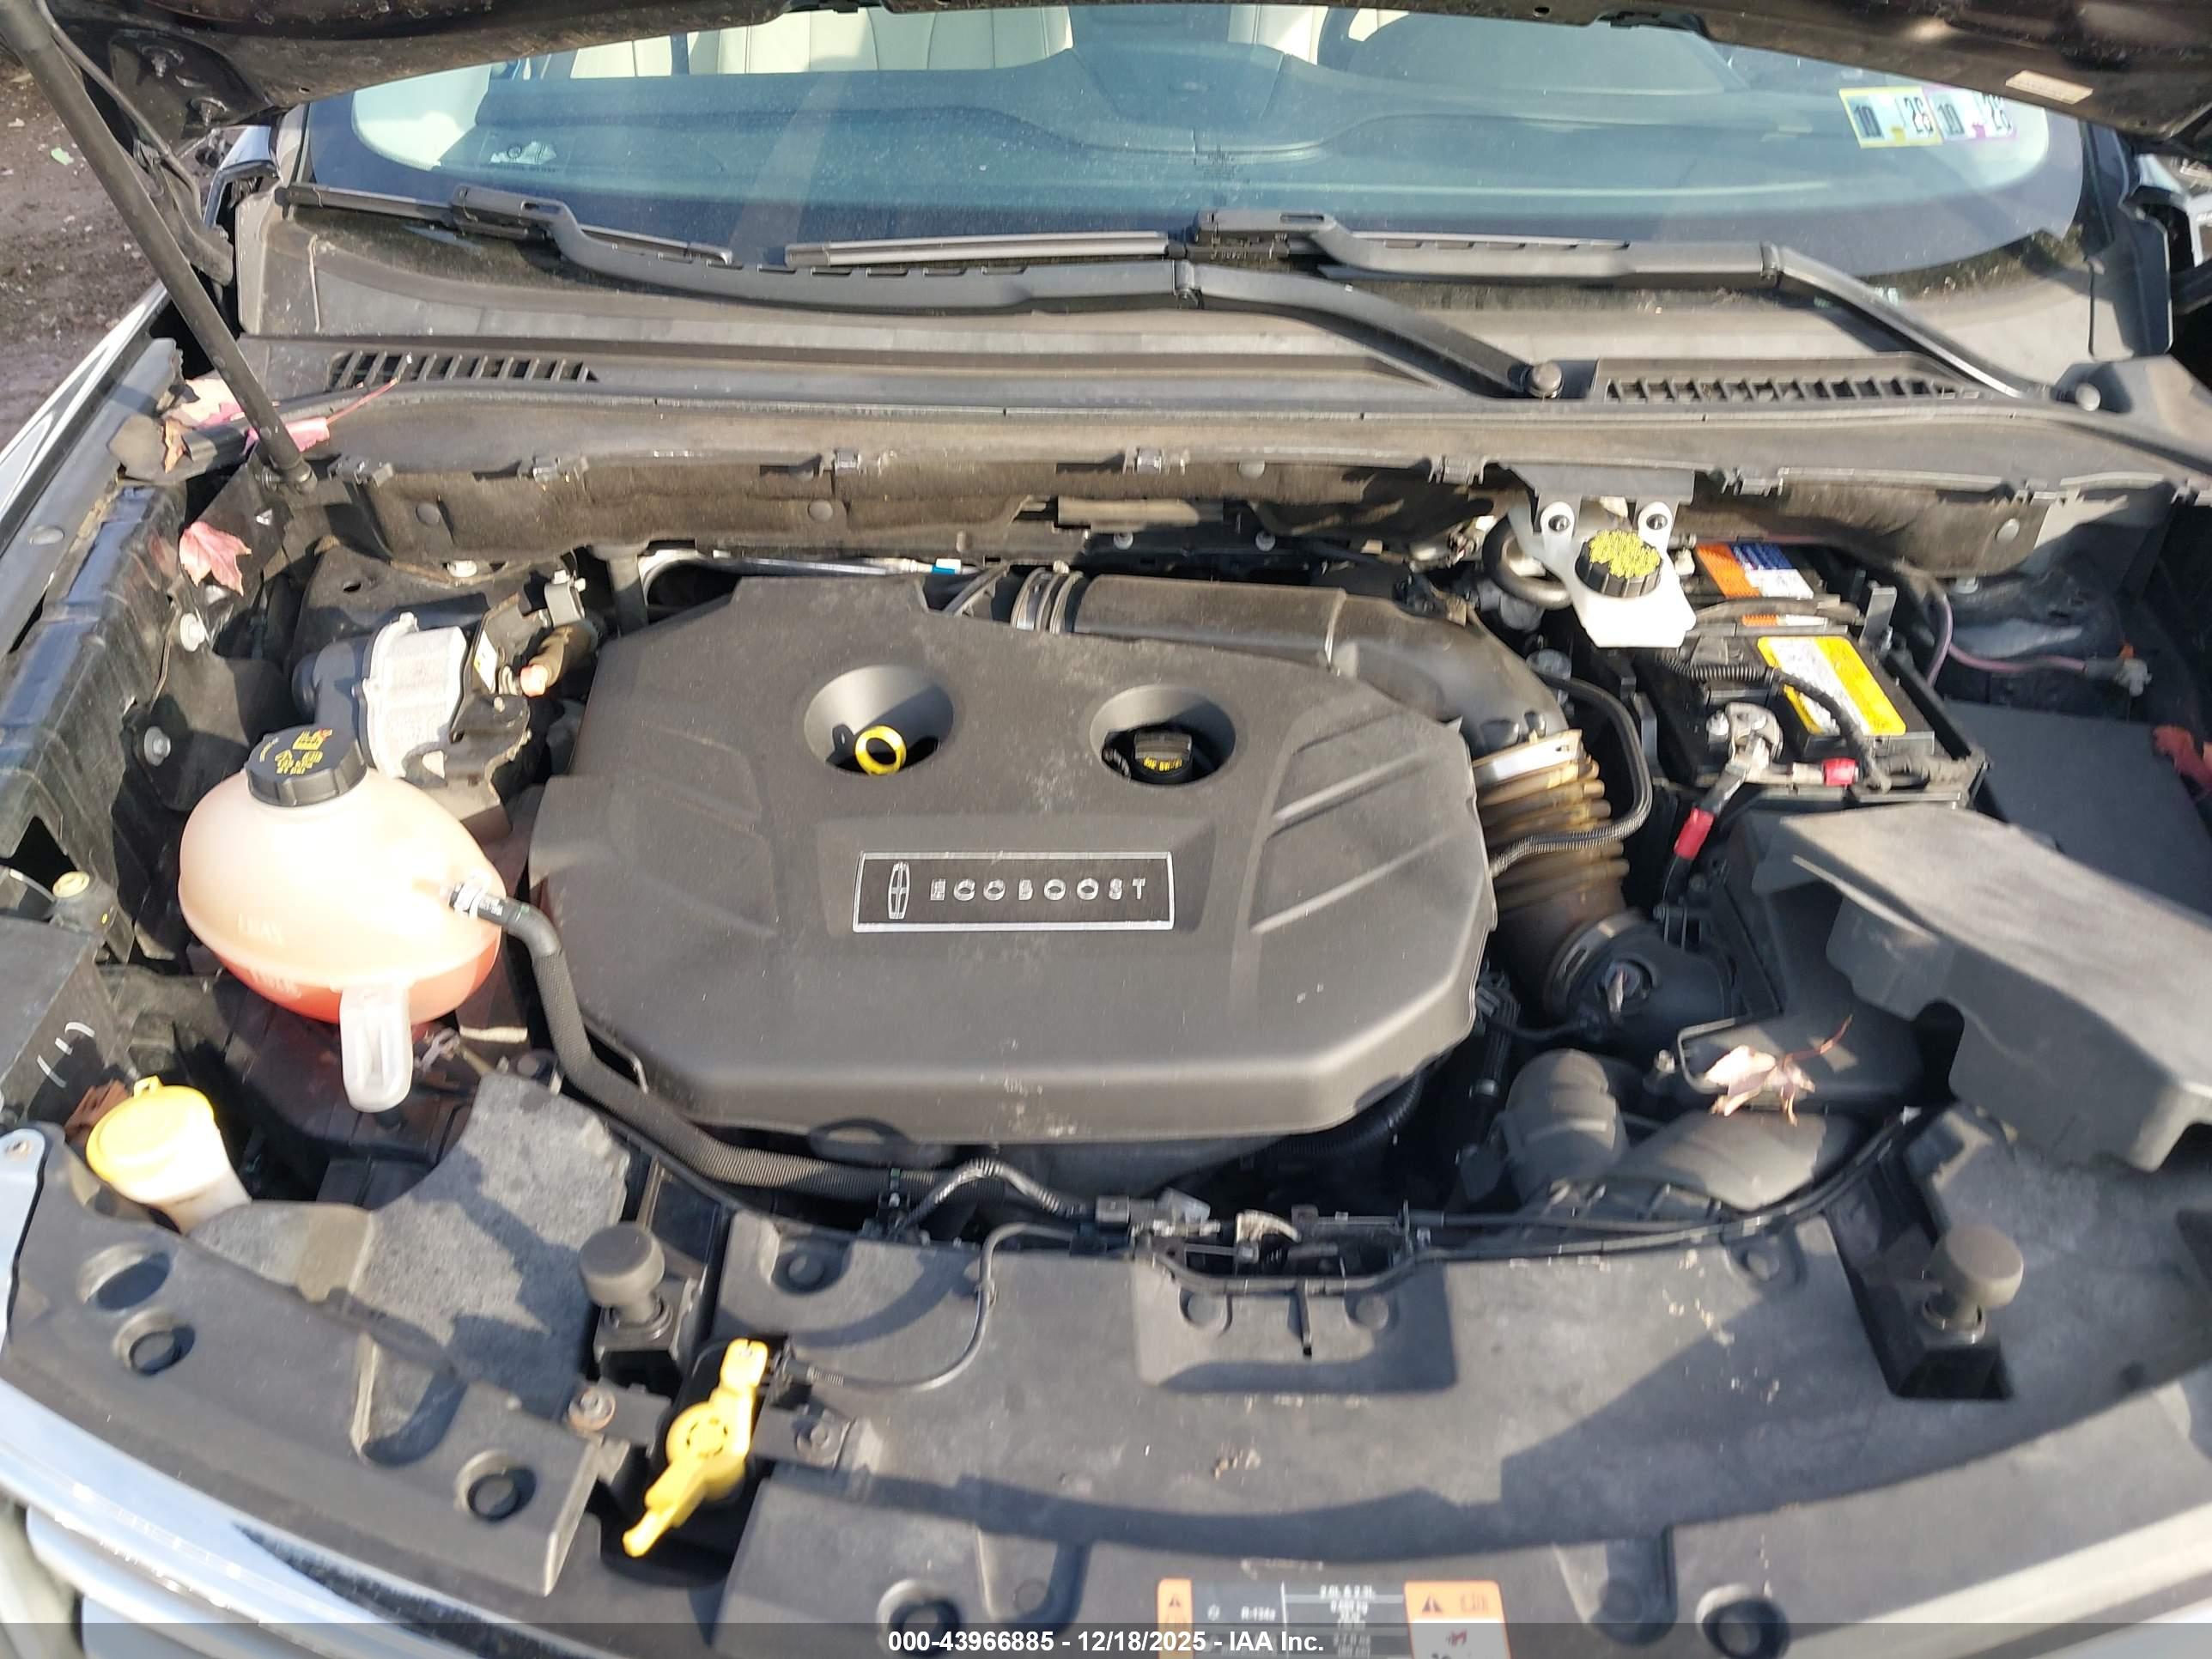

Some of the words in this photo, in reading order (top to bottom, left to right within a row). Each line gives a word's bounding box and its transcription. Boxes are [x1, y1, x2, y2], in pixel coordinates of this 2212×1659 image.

[1853, 105, 1883, 137] 10
[1937, 104, 1966, 136] 10
[930, 877, 1146, 902] ECOBOOST
